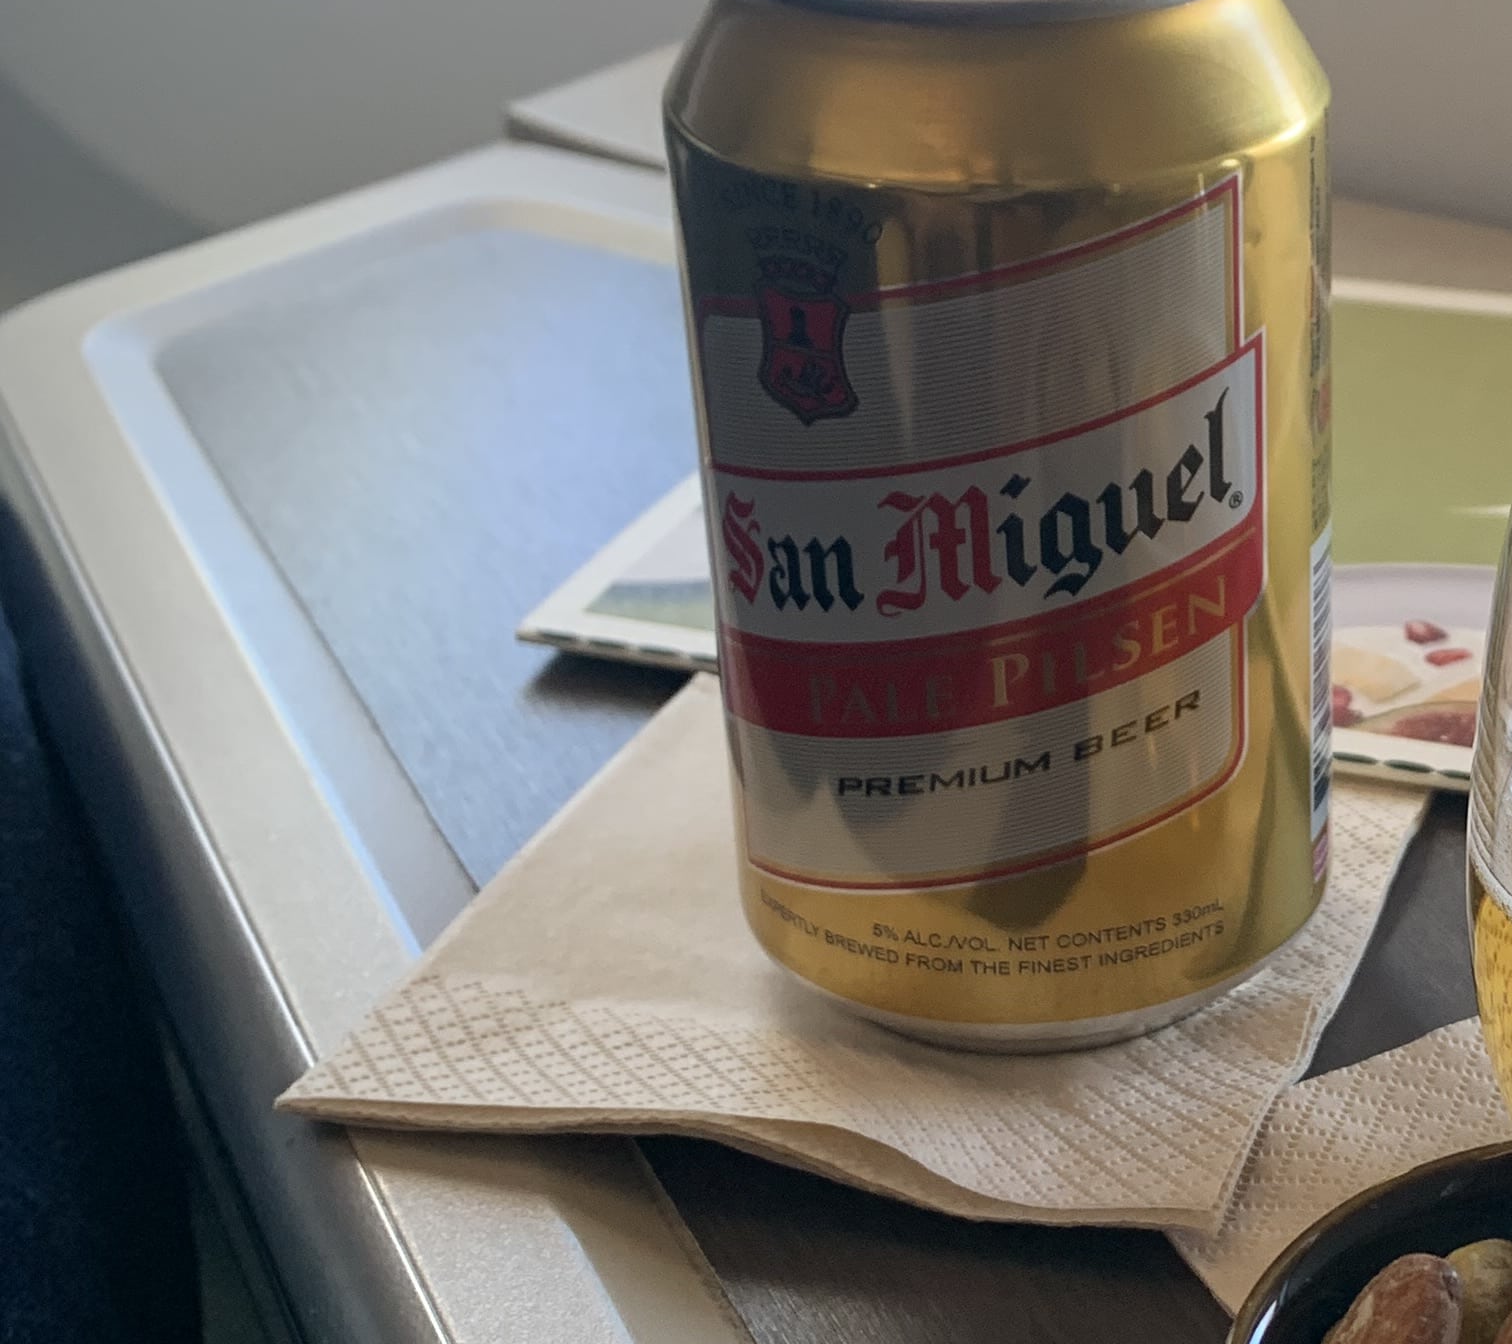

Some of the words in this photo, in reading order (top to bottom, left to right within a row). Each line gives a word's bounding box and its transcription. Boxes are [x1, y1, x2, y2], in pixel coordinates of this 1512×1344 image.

[722, 490, 864, 613] San
[807, 668, 960, 727] PALE
[988, 573, 1228, 708] PILSEN
[837, 747, 1052, 798] PREMIUM
[1072, 687, 1203, 763] BEER
[824, 928, 900, 965] BREWED
[905, 952, 964, 974] FROM
[970, 959, 1011, 976] THE
[1018, 953, 1092, 976] FINEST
[1097, 919, 1225, 967] INGREDIENTS
[872, 920, 899, 941] 5%
[1008, 935, 1048, 953] NET
[1058, 916, 1168, 950] CONTENTS
[1172, 897, 1225, 927] 330mL
